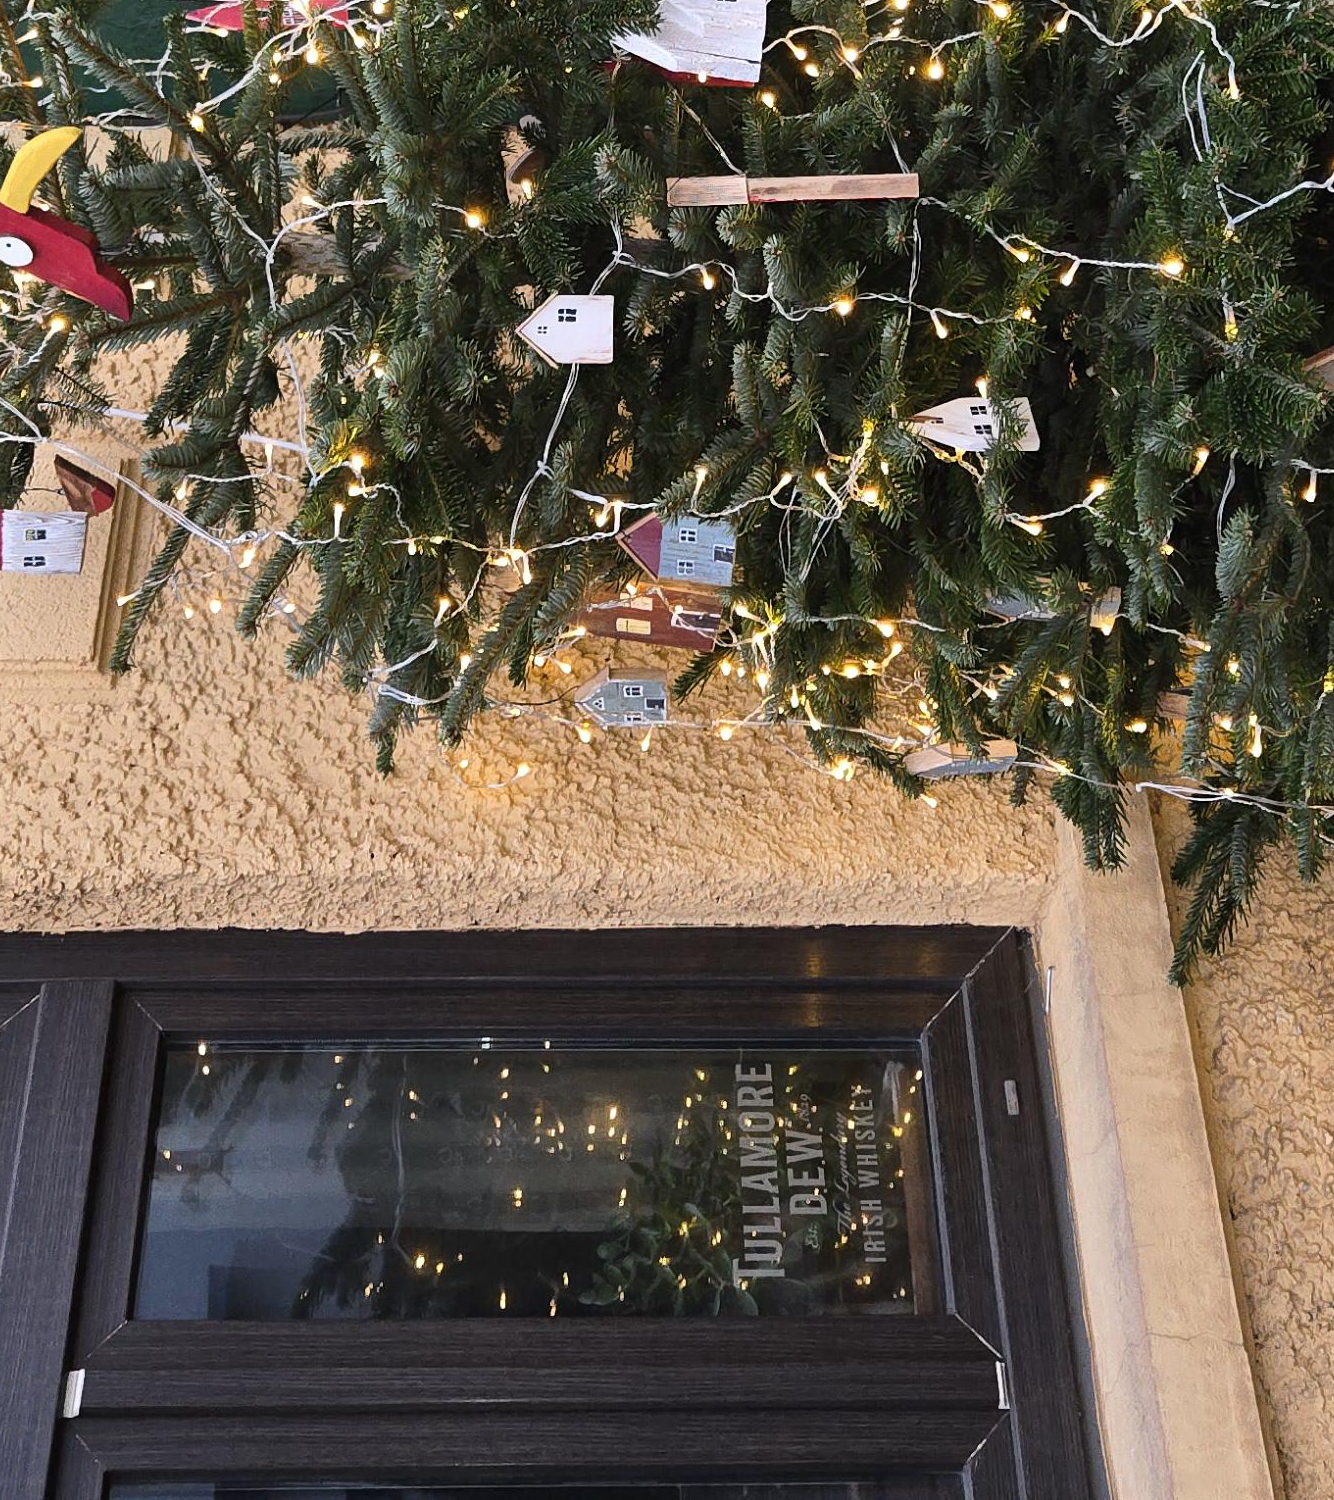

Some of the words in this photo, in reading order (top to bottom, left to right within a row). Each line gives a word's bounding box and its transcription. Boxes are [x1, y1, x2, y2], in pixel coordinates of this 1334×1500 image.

[732, 1062, 786, 1287] TULLAMORE
[784, 1126, 828, 1215] D.E.W.
[850, 1084, 880, 1188] WHISKEY
[832, 1202, 853, 1234] The
[859, 1199, 887, 1263] IRISH
